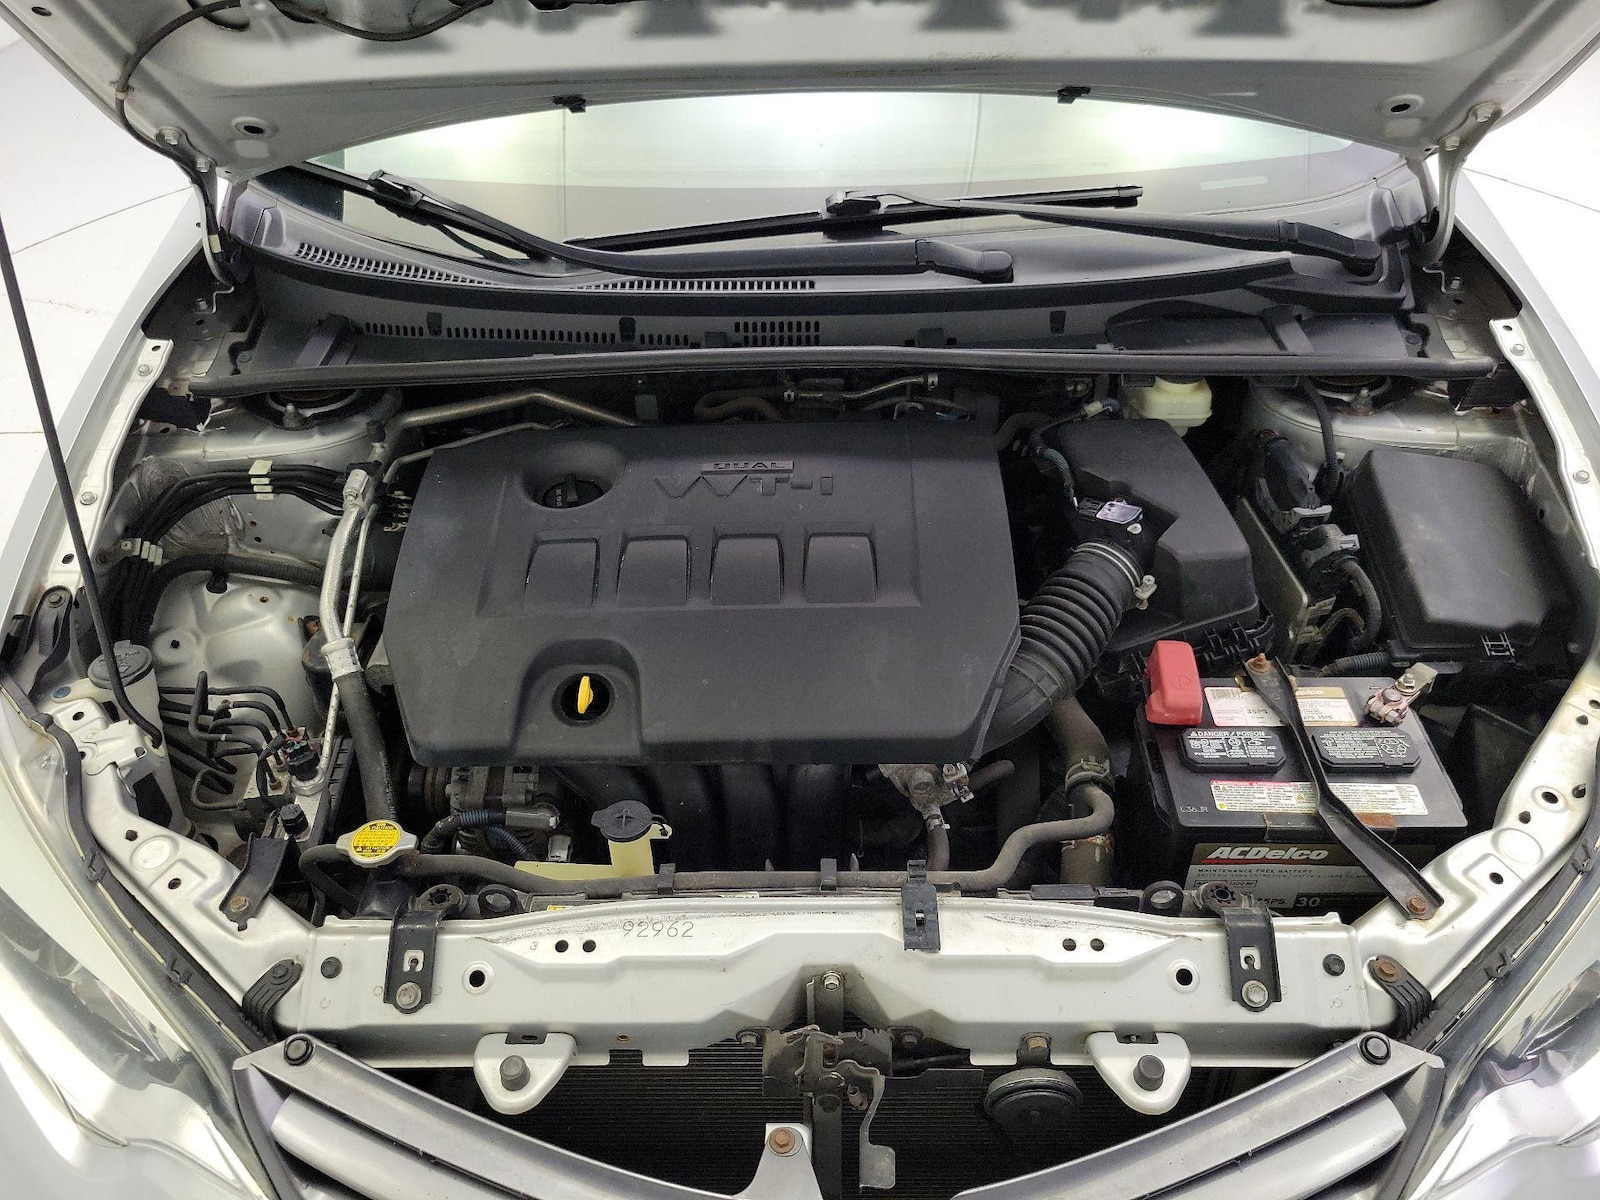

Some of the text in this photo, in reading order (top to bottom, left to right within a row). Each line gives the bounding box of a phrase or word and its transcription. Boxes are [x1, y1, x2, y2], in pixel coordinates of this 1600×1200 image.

[713, 461, 785, 470] DUAL
[1207, 846, 1329, 861] ACDelco
[623, 920, 695, 938] 92962
